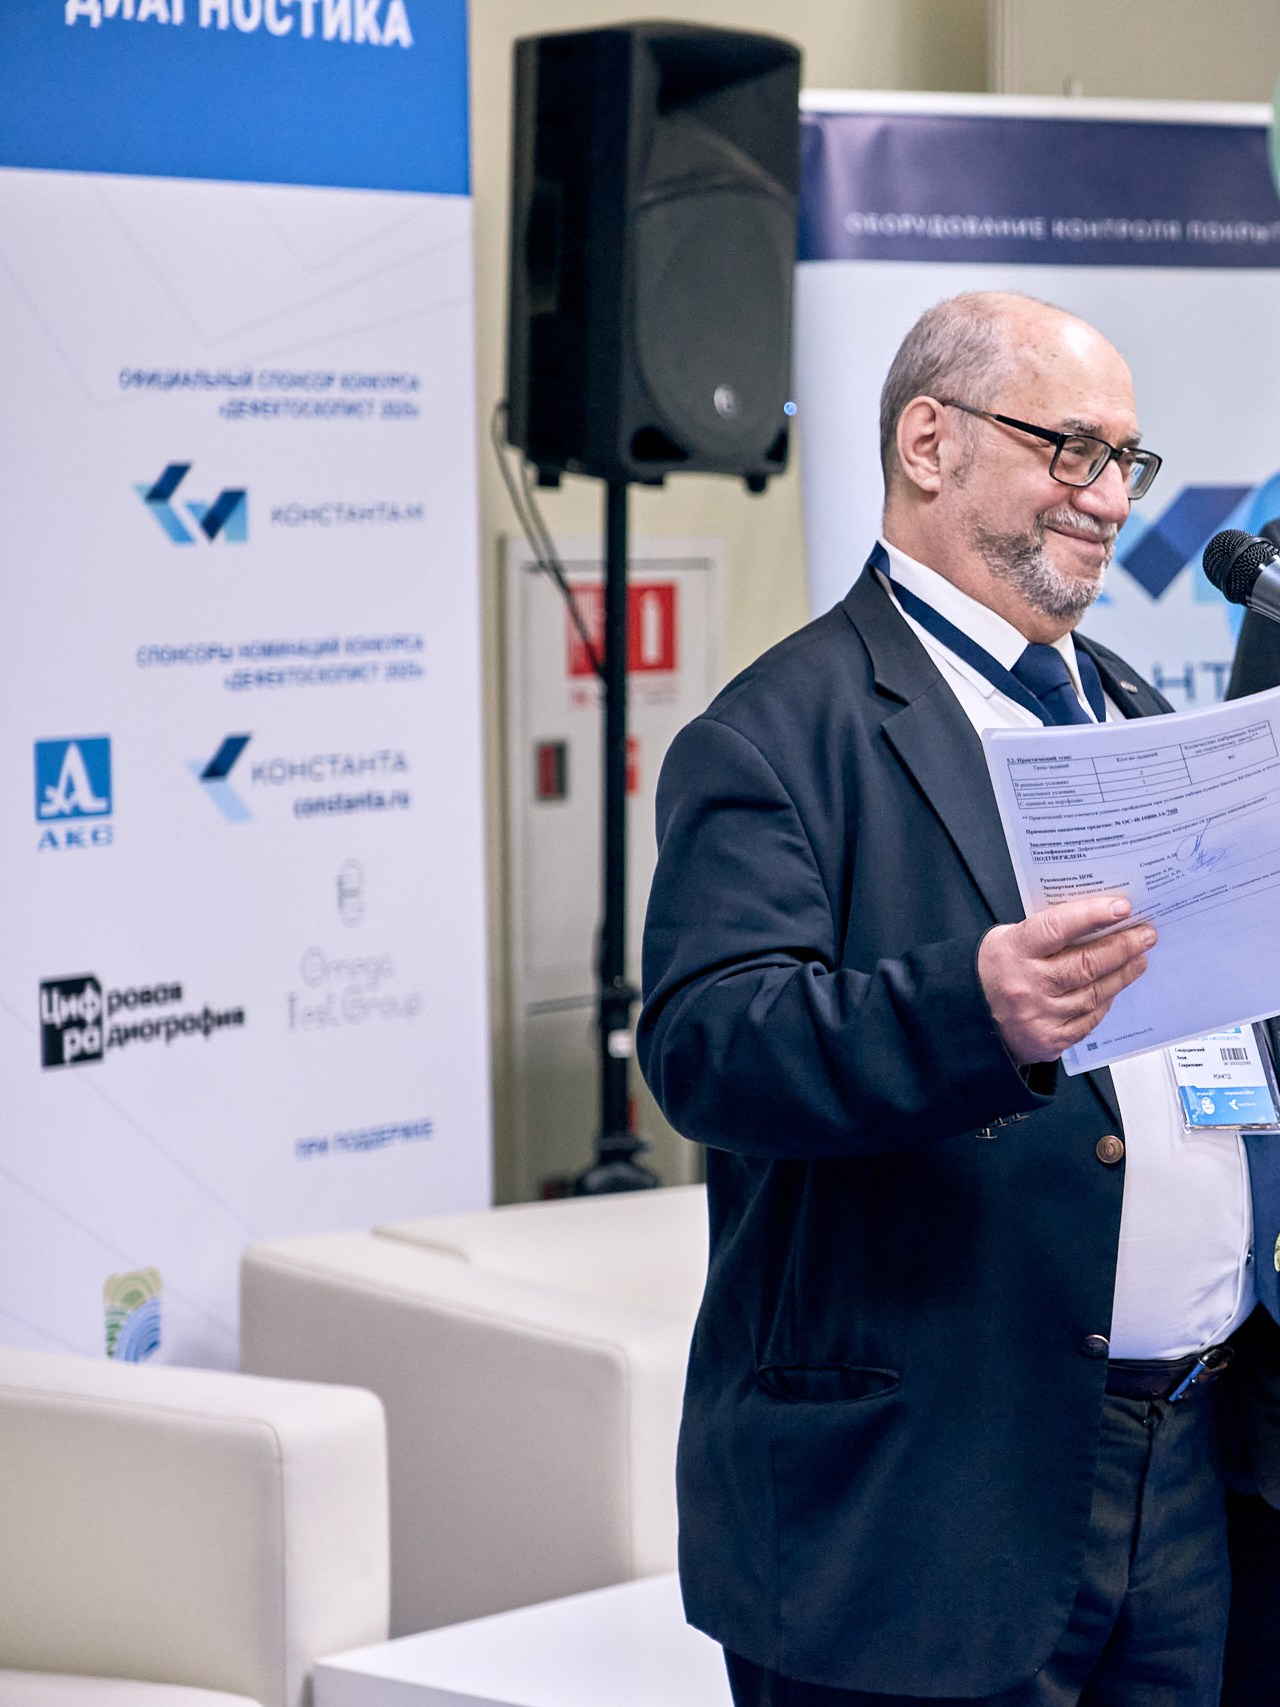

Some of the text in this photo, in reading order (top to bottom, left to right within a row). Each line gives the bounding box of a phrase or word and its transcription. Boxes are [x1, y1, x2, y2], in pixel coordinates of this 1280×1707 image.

[845, 210, 1047, 241] ОБОРУДОВАНИЕ
[1051, 215, 1183, 243] КОНТРОЛЯ
[119, 367, 254, 391] ОФИЦИАЛЬНЫЙ
[257, 370, 336, 392] СПОНСОР
[136, 644, 234, 668] СПОНСОРЫ
[251, 749, 409, 785] КОНСТАНТА
[294, 790, 411, 820] constanta.ru
[1034, 852, 1087, 863] ПОДТВЕРЖДЕНА
[334, 1116, 435, 1153] ПОДДЕРЖКЕ
